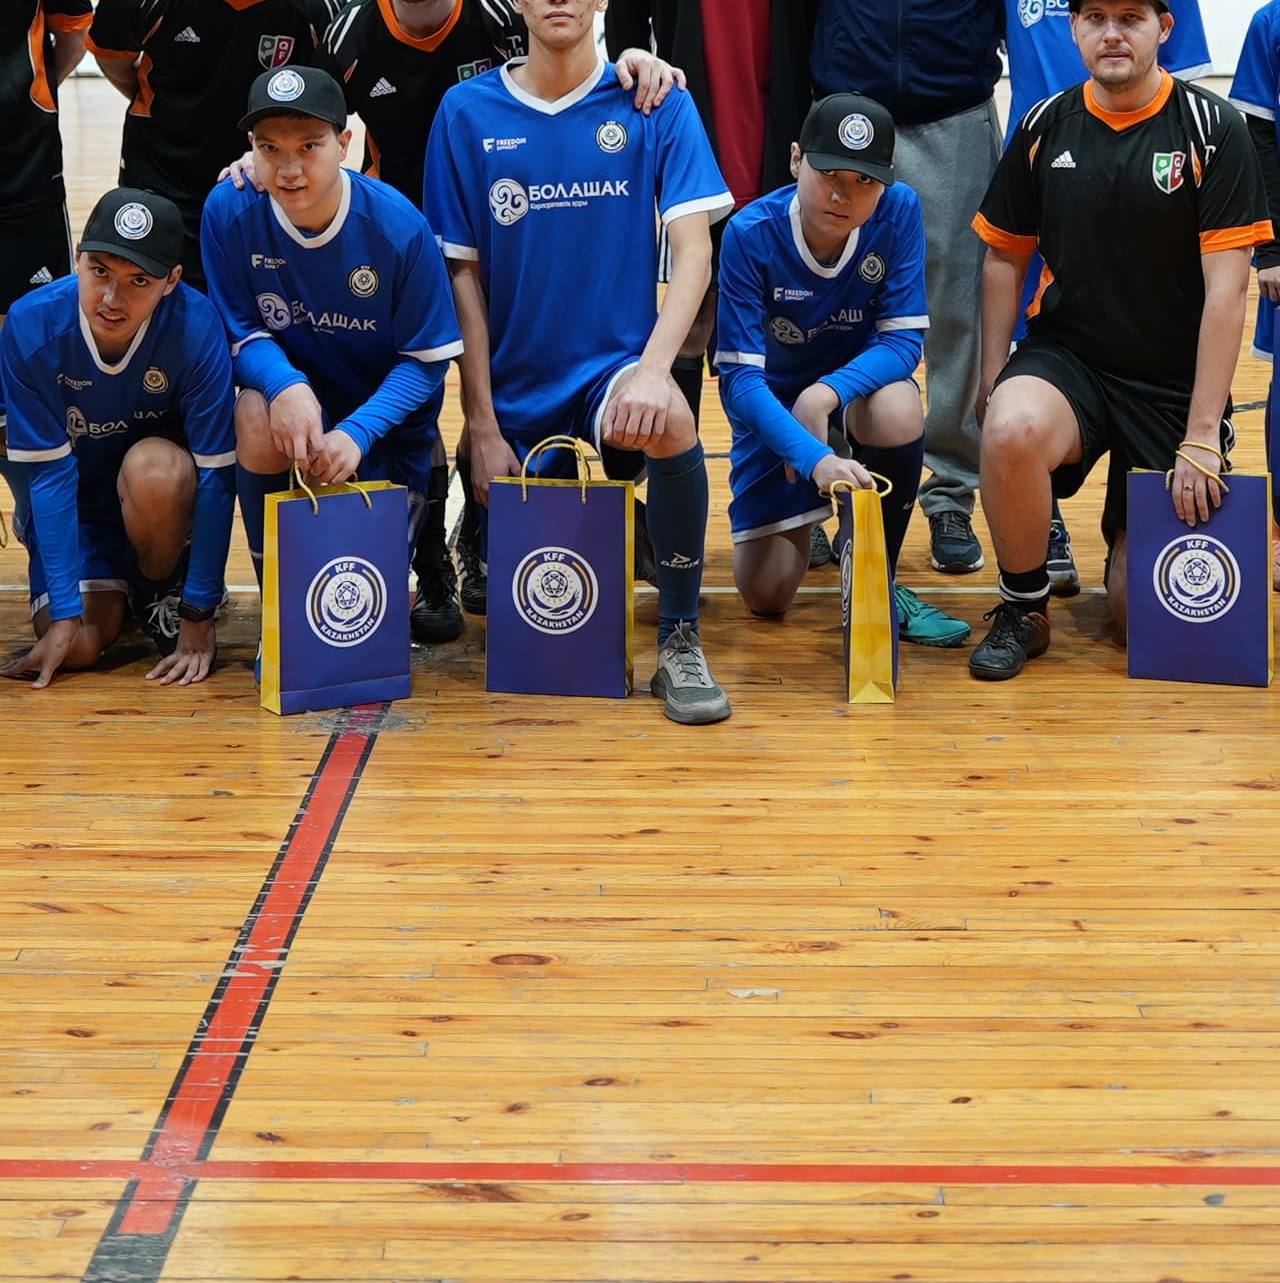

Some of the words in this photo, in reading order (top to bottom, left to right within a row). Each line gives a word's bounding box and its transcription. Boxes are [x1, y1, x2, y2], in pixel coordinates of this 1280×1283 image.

[529, 179, 630, 200] БОЛАШАК
[1187, 539, 1209, 550] KFF
[543, 552, 565, 563] KFF
[334, 563, 357, 575] KFF
[1165, 593, 1226, 617] KAZAKHSTAN
[319, 616, 377, 641] KAZAKHSTAN
[525, 606, 585, 631] KAZAKHSTAN
